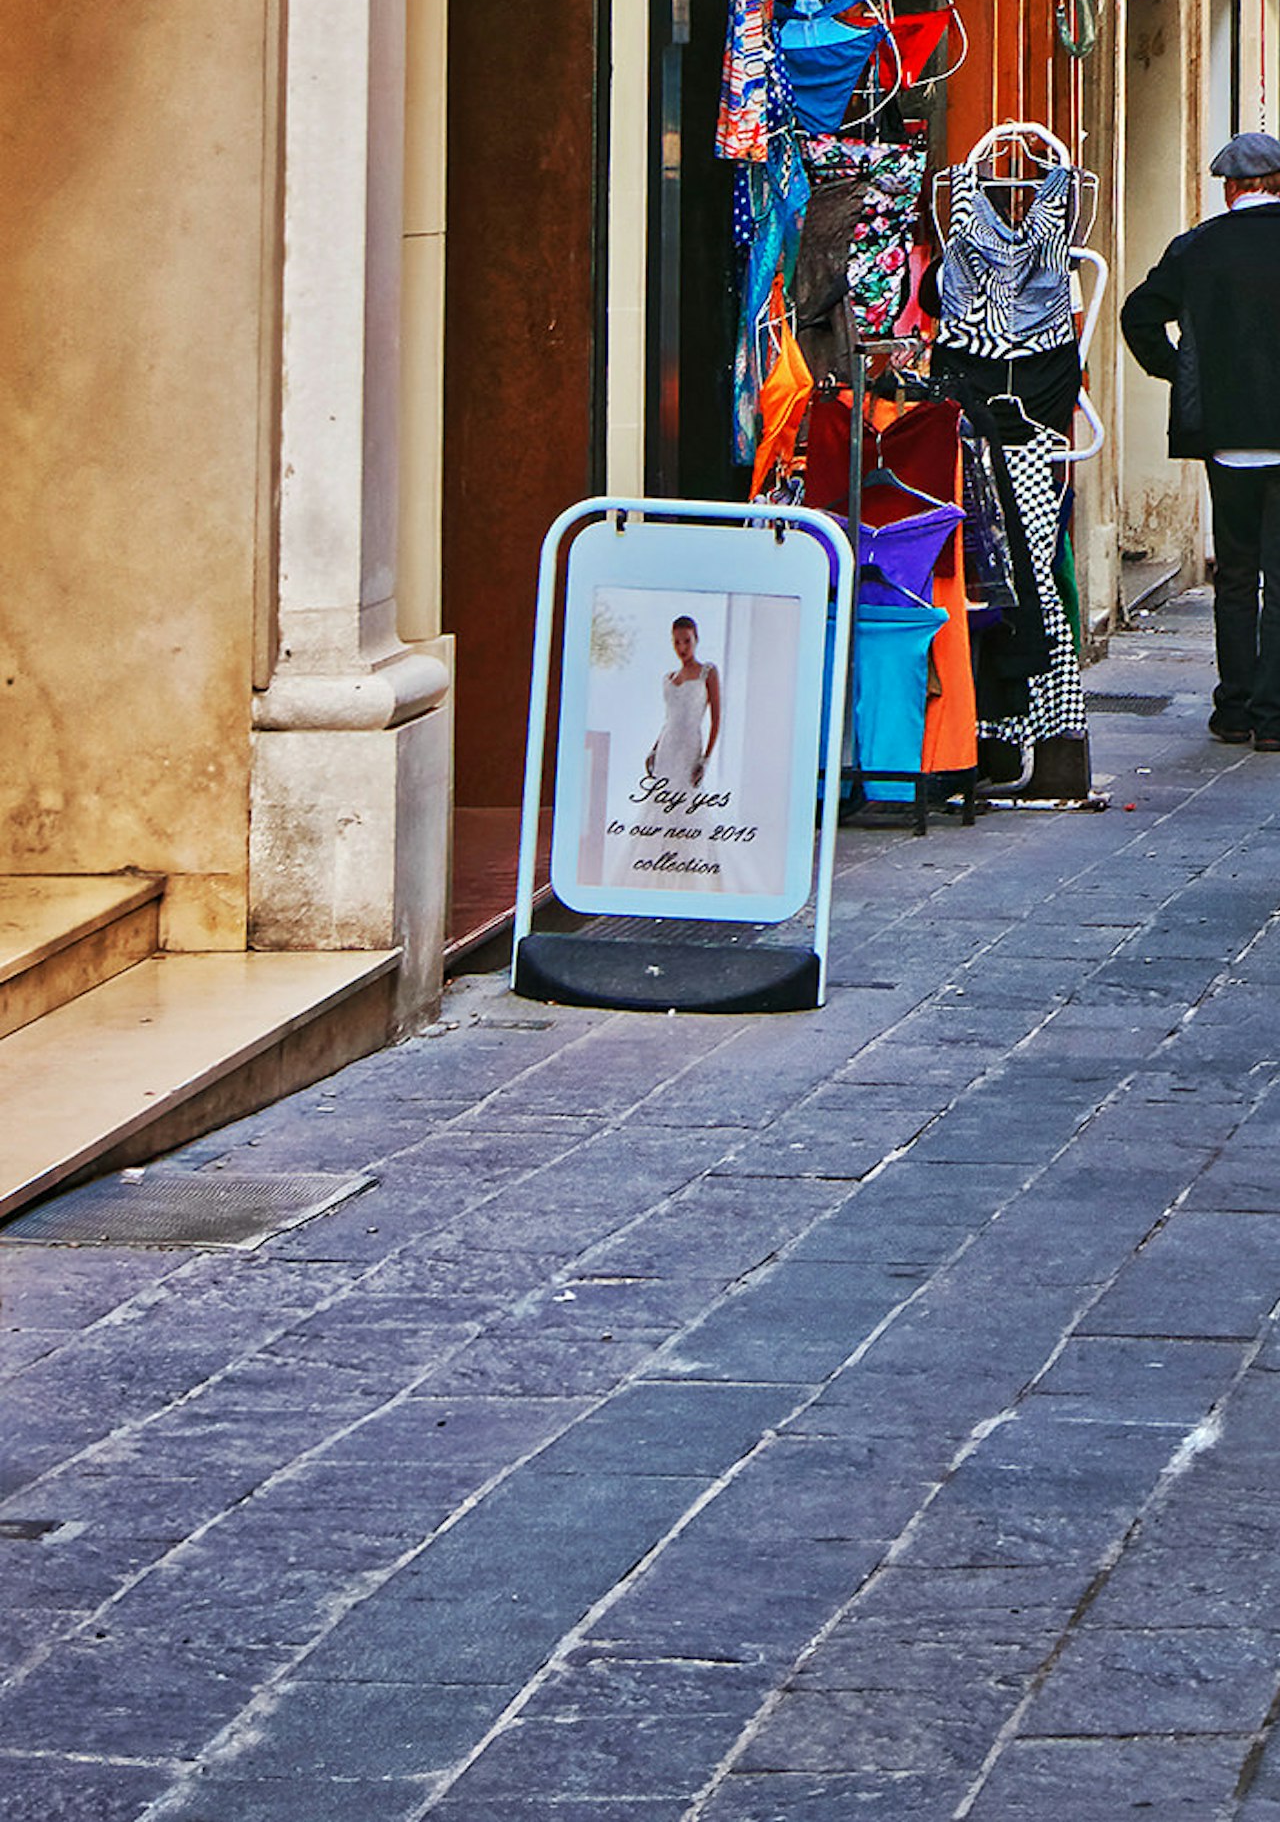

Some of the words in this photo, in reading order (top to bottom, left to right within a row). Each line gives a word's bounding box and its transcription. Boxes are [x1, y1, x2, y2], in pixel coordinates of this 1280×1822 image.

[629, 775, 688, 815] Say
[685, 791, 731, 815] yes
[607, 819, 626, 835] to
[629, 825, 663, 838] our
[663, 826, 702, 840] new
[709, 824, 759, 843] 2015
[633, 852, 722, 875] collection
